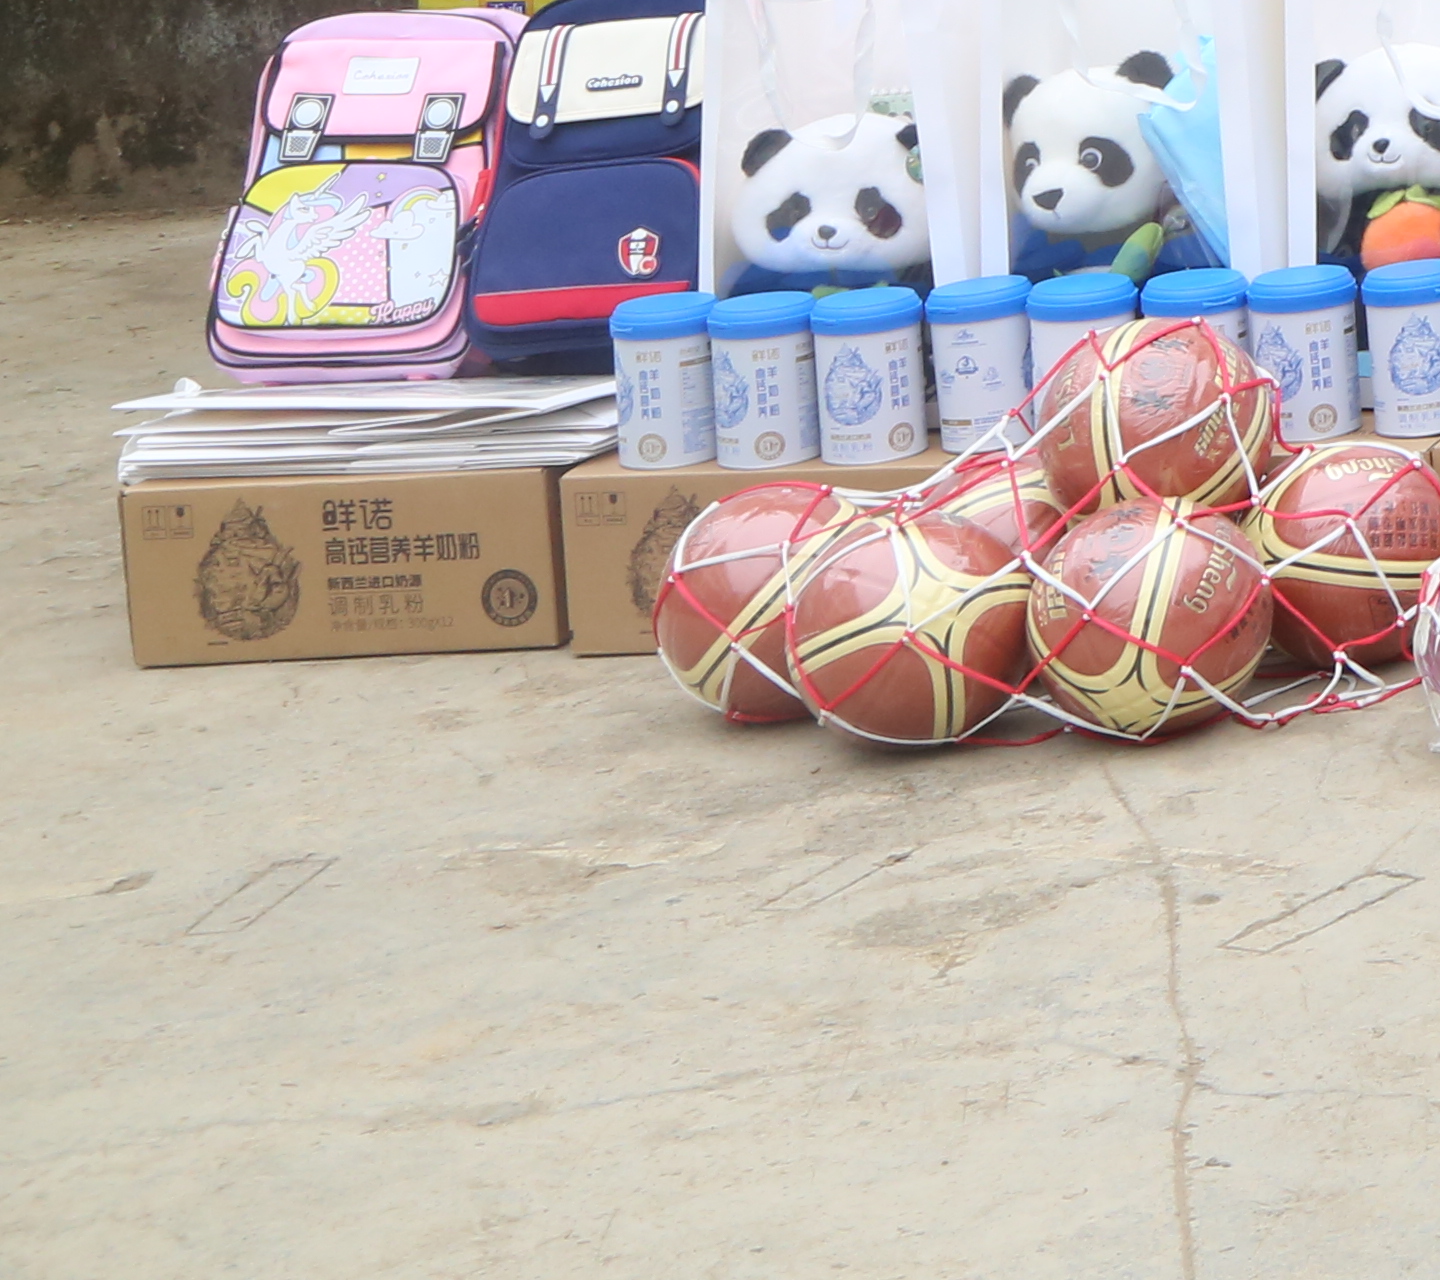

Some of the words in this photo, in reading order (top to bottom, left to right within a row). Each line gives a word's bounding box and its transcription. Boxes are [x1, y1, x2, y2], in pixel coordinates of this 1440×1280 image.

[586, 74, 640, 91] Cohesion
[370, 297, 435, 325] Happy
[321, 499, 393, 531] 鲜诺
[324, 532, 481, 566] 高钙营养羊奶粉
[327, 574, 422, 591] 新西兰进口奶源
[328, 593, 425, 615] 调制乳粉
